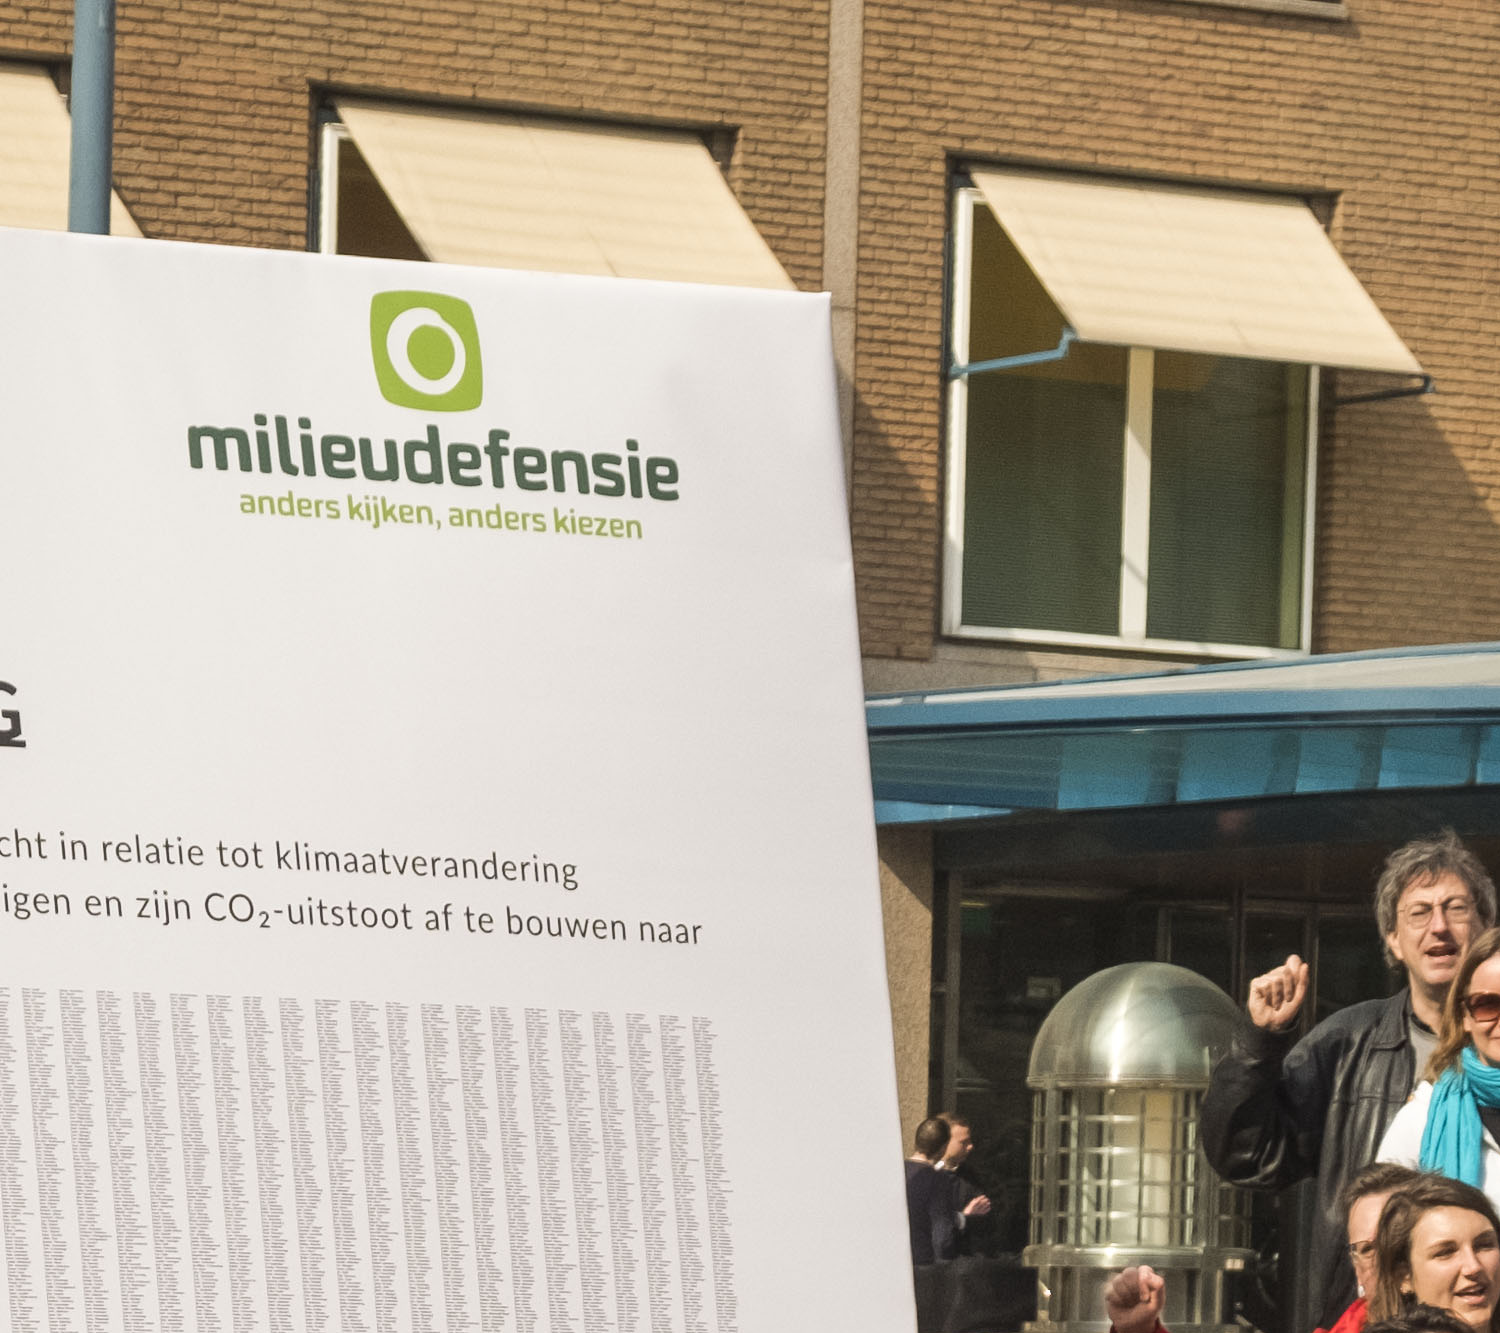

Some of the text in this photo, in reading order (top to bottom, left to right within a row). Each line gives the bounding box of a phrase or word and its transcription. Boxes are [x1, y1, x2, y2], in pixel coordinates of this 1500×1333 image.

[188, 414, 679, 501] milieudefensie
[241, 493, 641, 537] anders kijken, anders kiezen
[60, 831, 87, 860] in
[103, 835, 203, 865] relatie
[217, 841, 263, 868] tot
[276, 841, 578, 890] klimaatverandering
[85, 896, 122, 916] en
[136, 890, 190, 925] zijn
[426, 904, 452, 931] af
[464, 907, 493, 933] te
[507, 906, 626, 940] bouwen
[640, 922, 701, 944] naar
